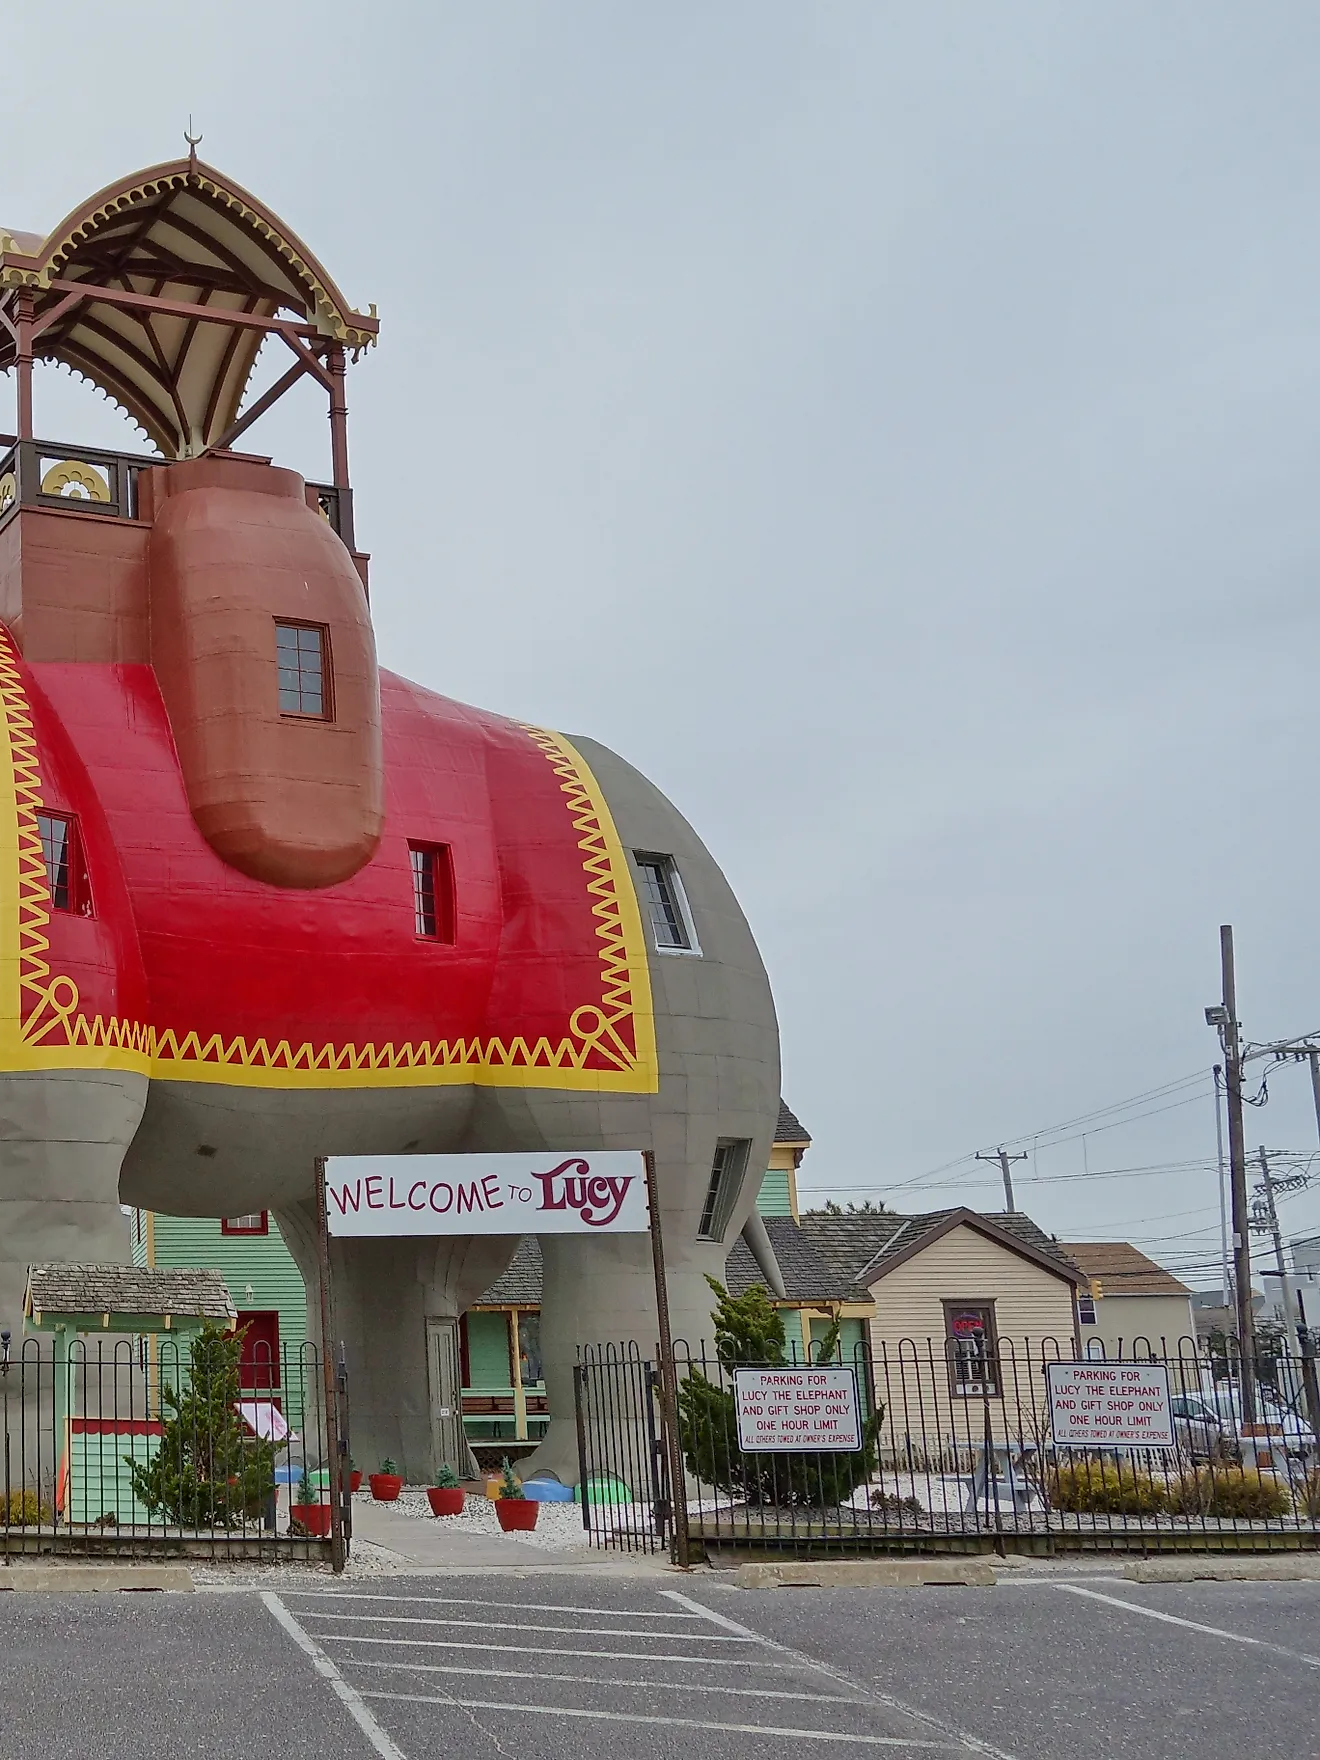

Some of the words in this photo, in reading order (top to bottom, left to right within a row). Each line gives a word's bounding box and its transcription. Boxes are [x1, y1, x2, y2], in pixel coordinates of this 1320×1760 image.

[330, 1175, 504, 1215] WELCOME
[507, 1184, 533, 1203] TO
[760, 1376, 803, 1385] PARKING
[808, 1376, 827, 1385] FOR
[1073, 1370, 1116, 1380] PARKING
[1121, 1371, 1141, 1381] FOR
[742, 1391, 768, 1401] LUCY
[773, 1391, 791, 1400] THE
[796, 1390, 847, 1400] ELEPHANT
[1055, 1385, 1081, 1395] LUCY
[1085, 1385, 1105, 1395] THE
[1109, 1386, 1161, 1396] ELEPHANT
[742, 1406, 763, 1415] AND
[768, 1406, 788, 1415] GIFT
[794, 1405, 821, 1415] SHOP
[825, 1405, 850, 1415] ONLY
[1055, 1400, 1076, 1410] AND
[1081, 1401, 1102, 1410] GIFT
[1106, 1401, 1134, 1411] SHOP
[1138, 1402, 1164, 1412] ONLY
[756, 1420, 776, 1430] ONE
[781, 1420, 809, 1430] HOUR
[814, 1420, 839, 1430] LIMIT
[1069, 1415, 1090, 1425] ONE
[1094, 1415, 1123, 1425] HOUR
[1127, 1416, 1152, 1426] LIMIT
